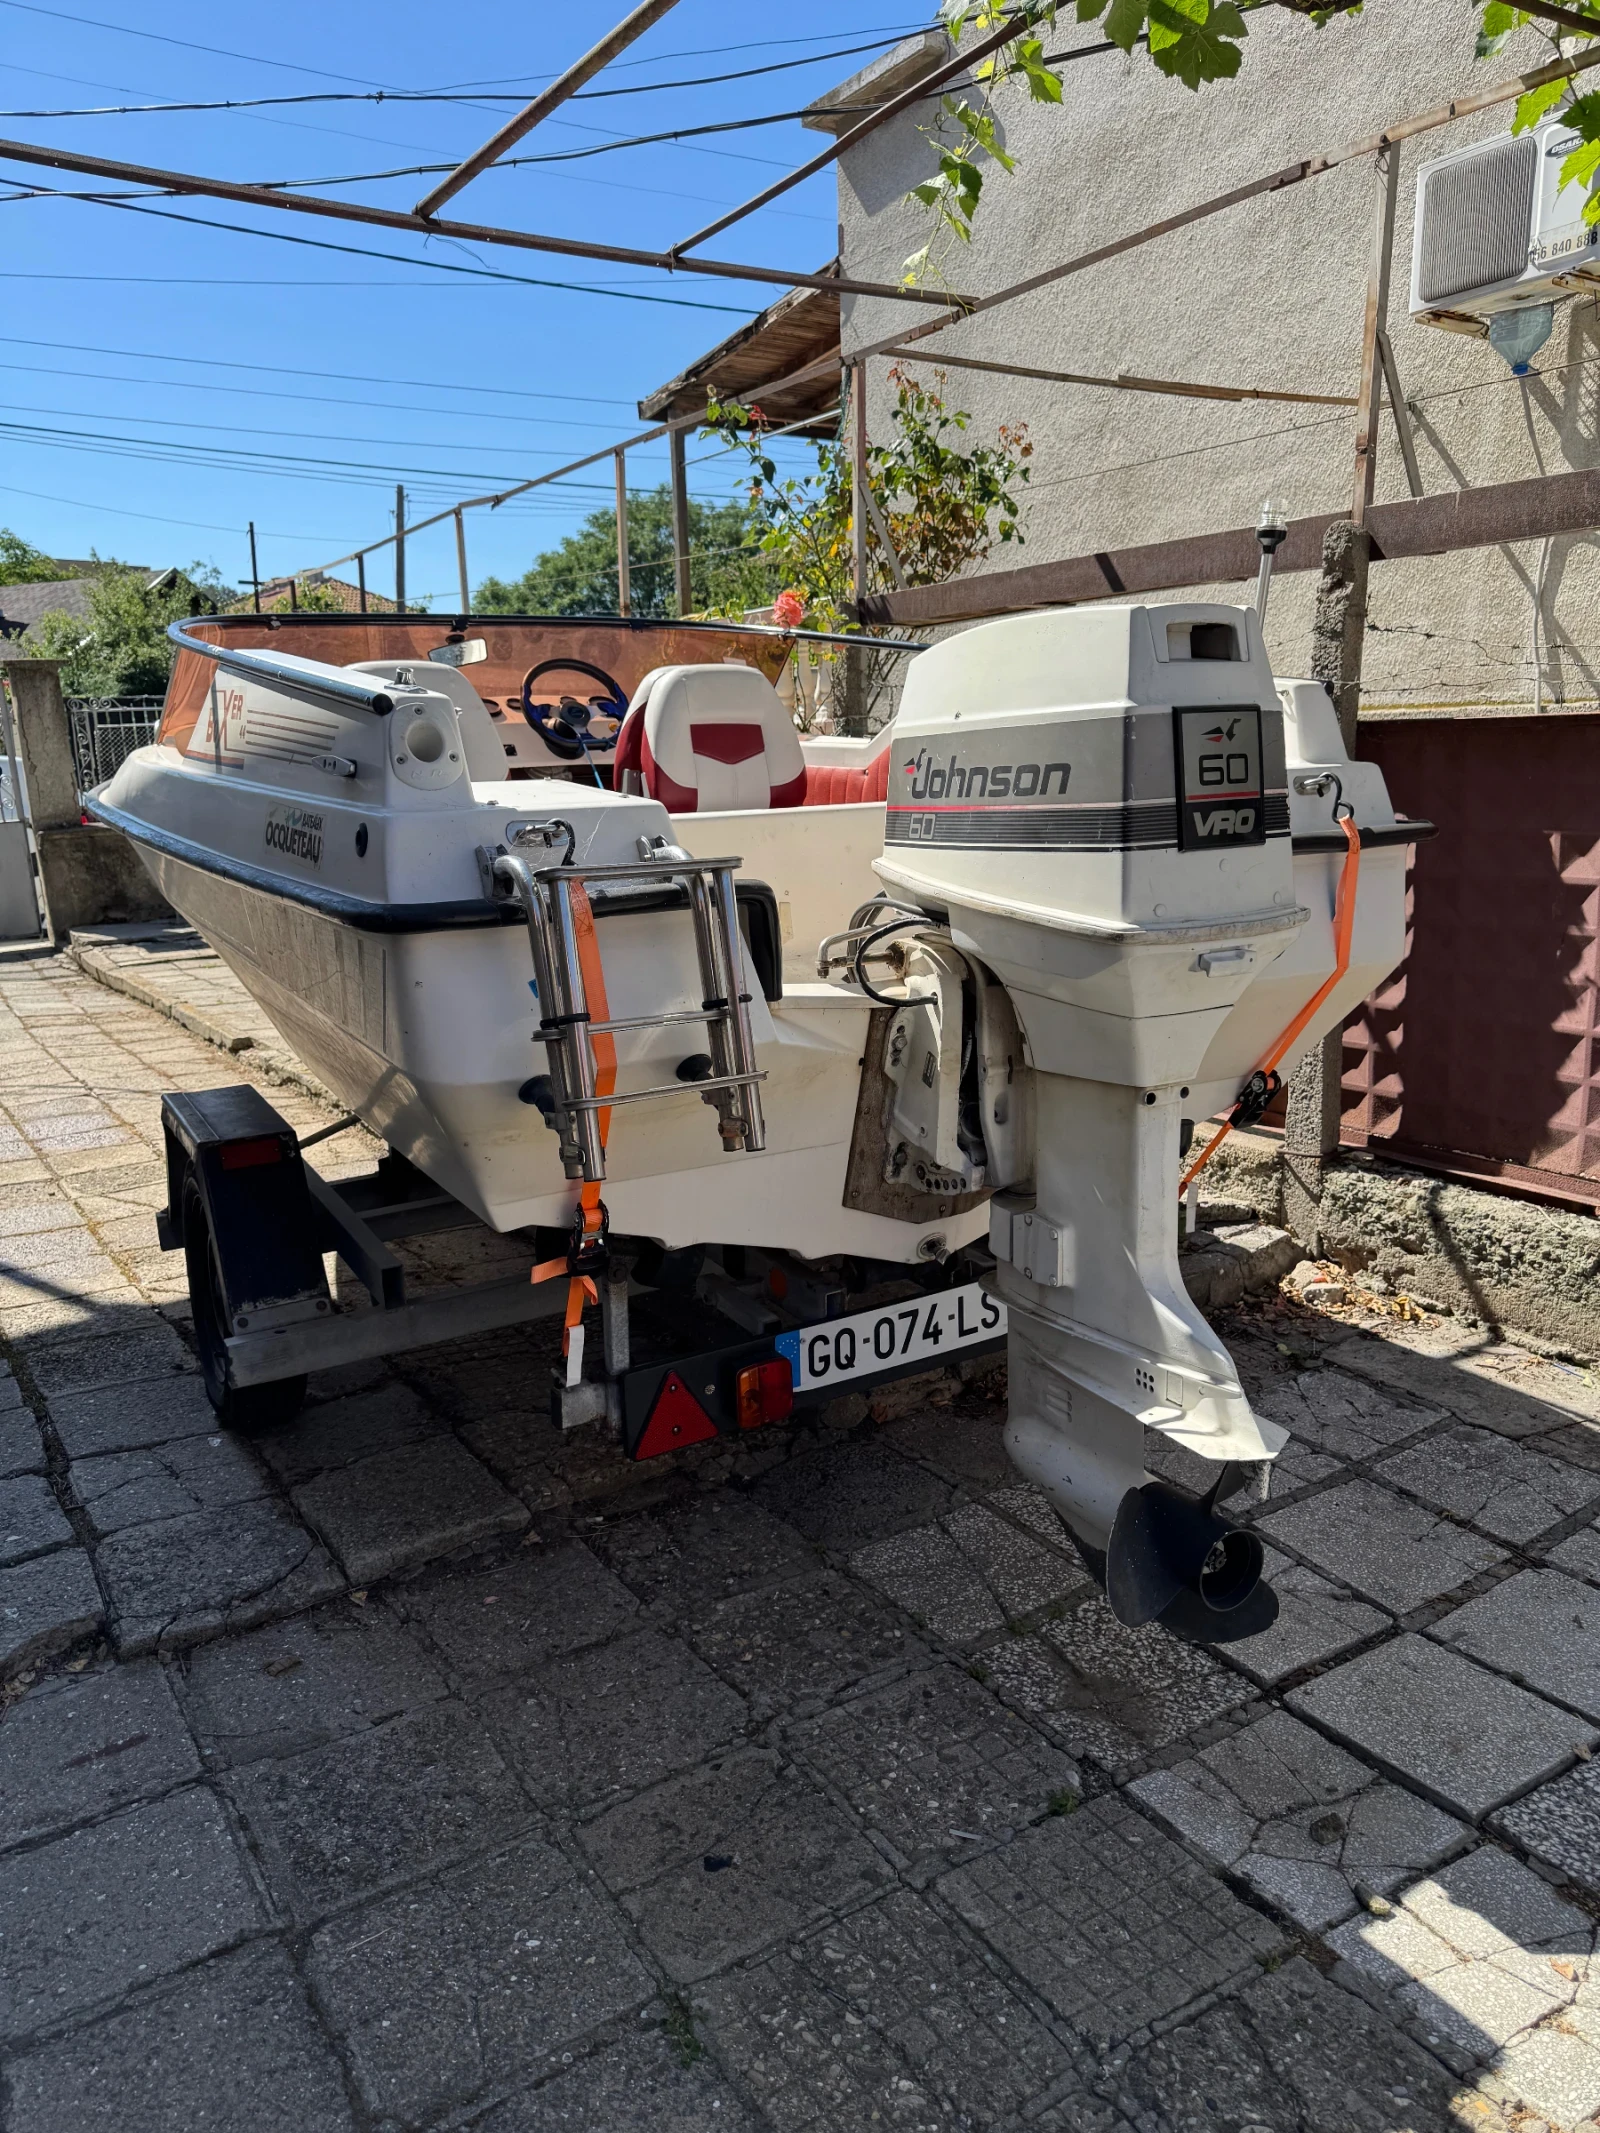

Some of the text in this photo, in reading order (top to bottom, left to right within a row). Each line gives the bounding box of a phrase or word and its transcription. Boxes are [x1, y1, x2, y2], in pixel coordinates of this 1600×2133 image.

[1551, 136, 1585, 153] OSAK
[1552, 238, 1572, 256] 840
[1577, 231, 1598, 248] 888
[911, 755, 1072, 799] Johnson
[1198, 753, 1249, 786] 60
[909, 813, 936, 839] 60
[1193, 808, 1256, 837] VRO
[266, 820, 321, 864] OCQUETEAU
[808, 1292, 1000, 1377] GQ-074-LS
